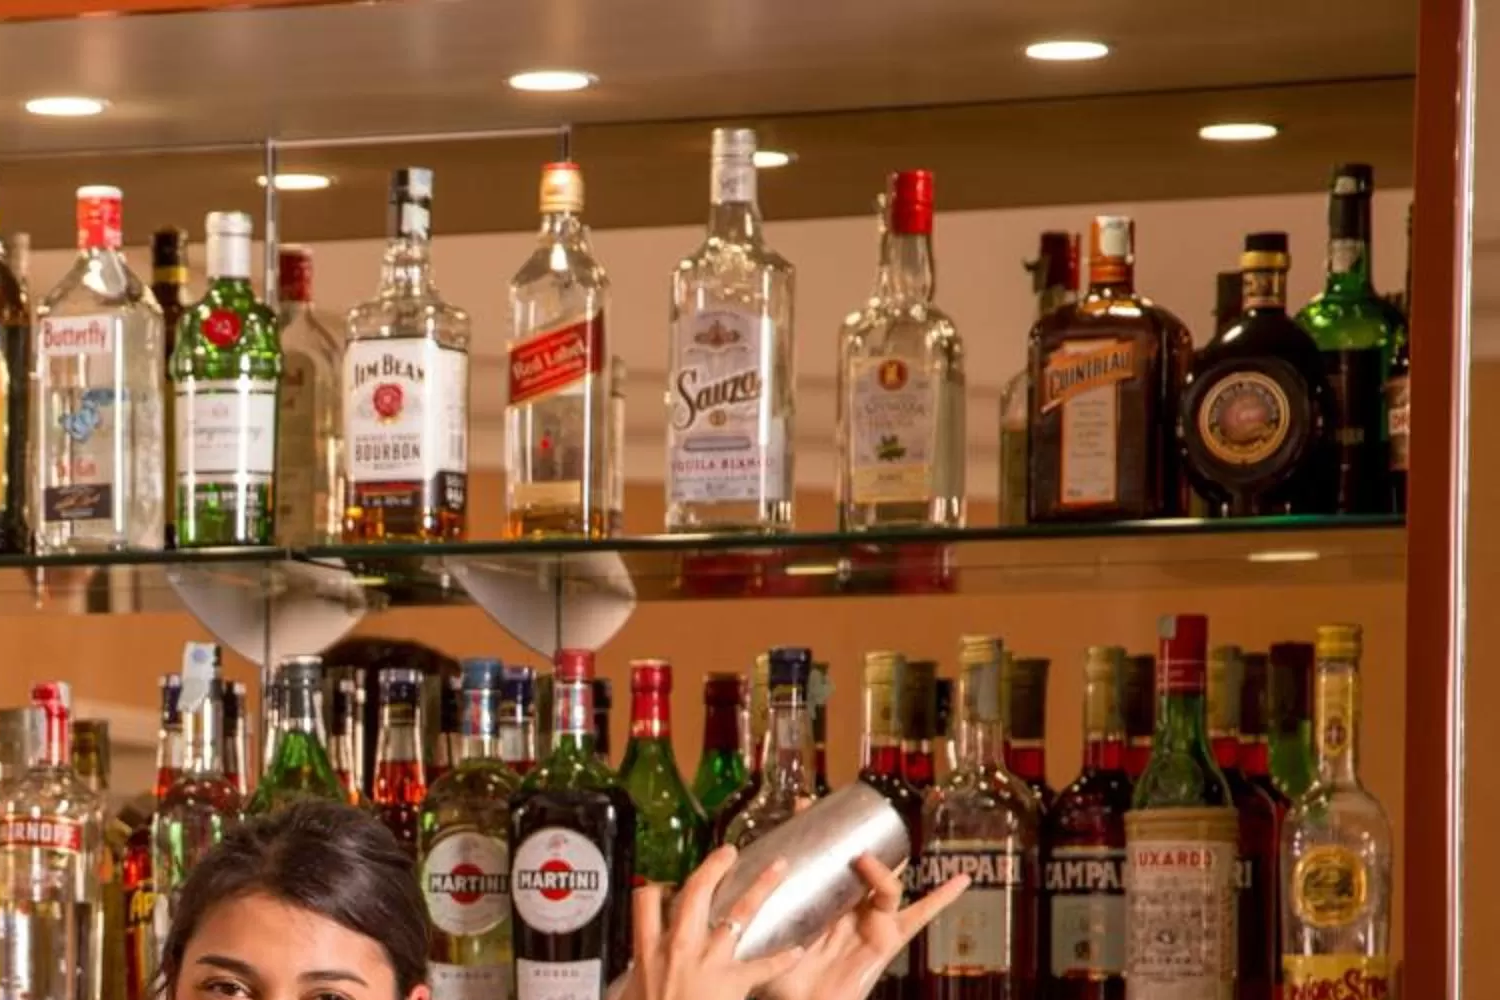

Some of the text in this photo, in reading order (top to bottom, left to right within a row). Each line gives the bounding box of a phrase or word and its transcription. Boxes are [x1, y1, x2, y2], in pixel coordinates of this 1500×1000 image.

[43, 320, 107, 350] Butterfly
[354, 353, 426, 388] JIM BEAM
[511, 337, 586, 380] Red Label
[355, 443, 421, 461] BOURBON
[429, 874, 508, 893] MARTINI
[518, 871, 599, 890] MARTINI
[921, 854, 1022, 884] CAMPARI
[1045, 859, 1126, 890] CAMPA
